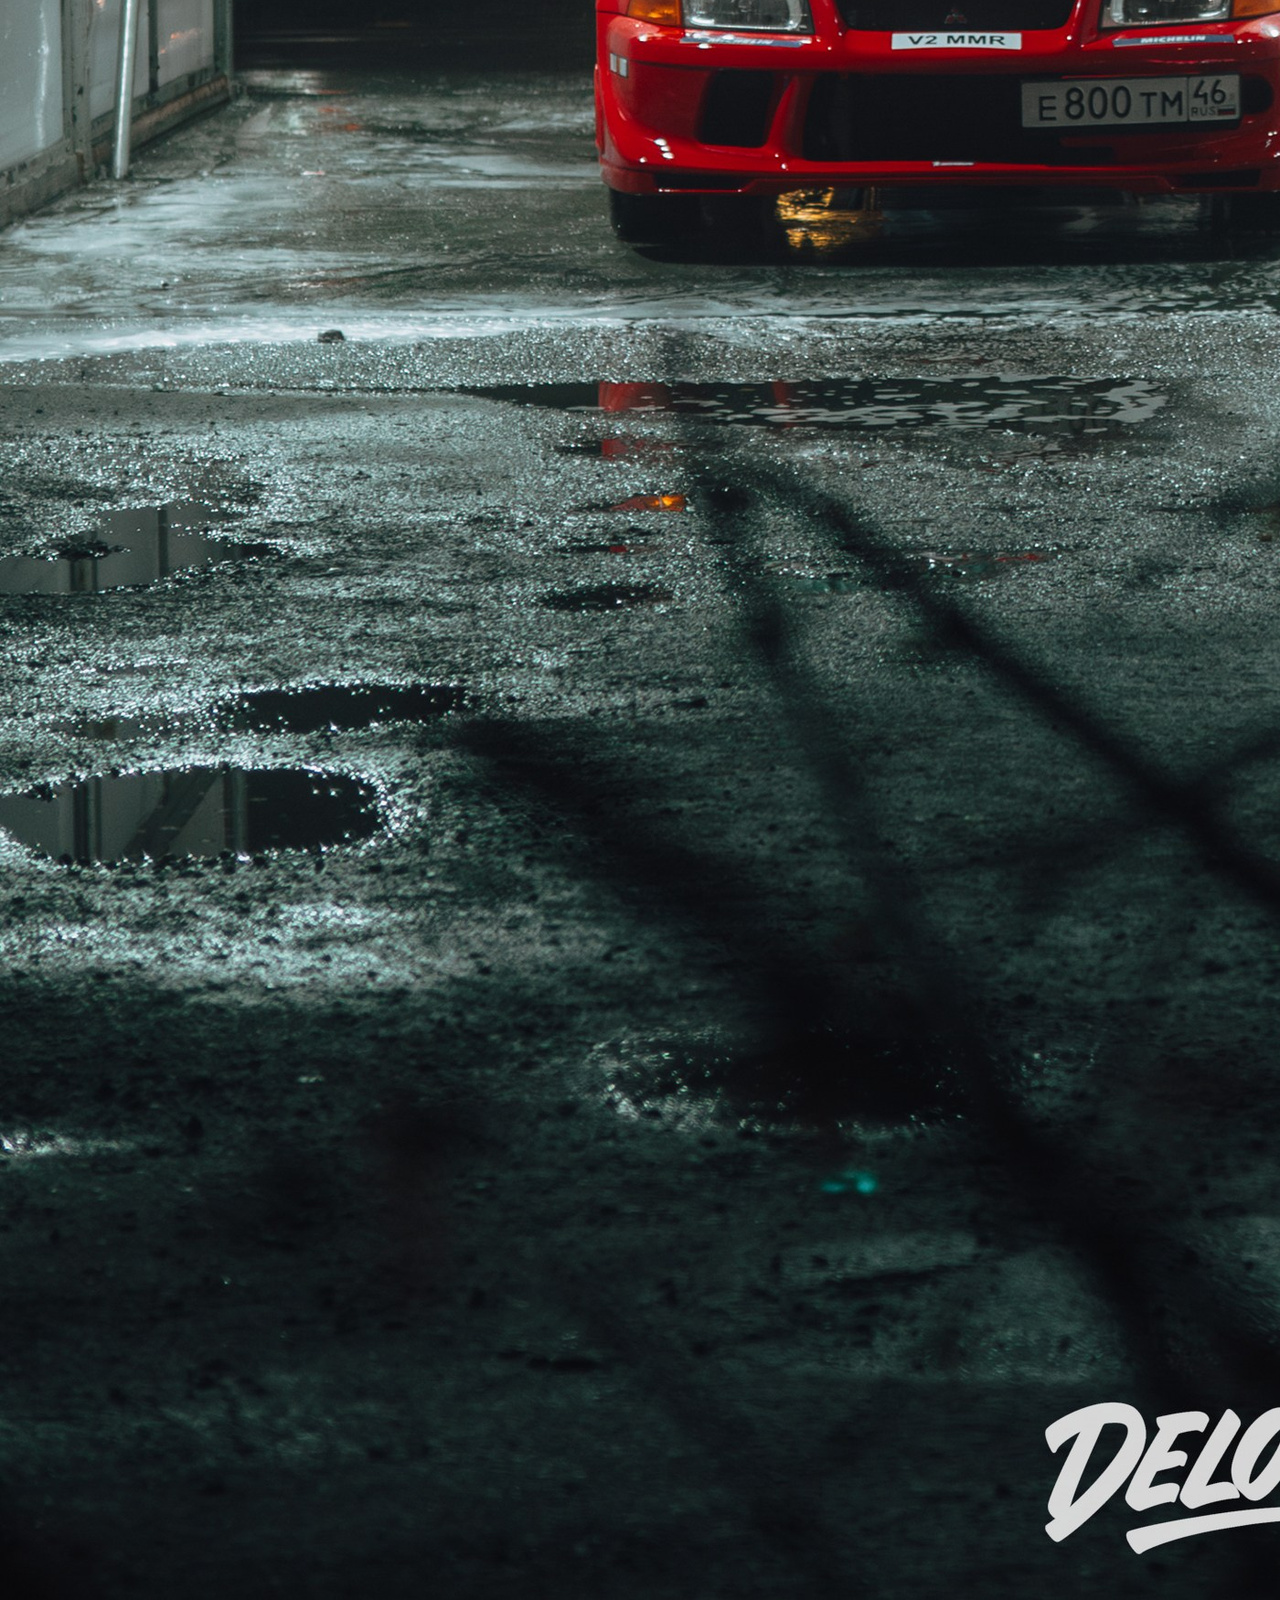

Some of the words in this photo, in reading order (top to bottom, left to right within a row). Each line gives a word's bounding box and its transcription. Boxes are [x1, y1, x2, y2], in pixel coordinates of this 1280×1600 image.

[908, 35, 938, 45] V2
[946, 35, 1006, 46] MMR
[1140, 35, 1207, 44] MICHELIN
[1192, 79, 1227, 105] 46
[1191, 106, 1216, 117] RUS
